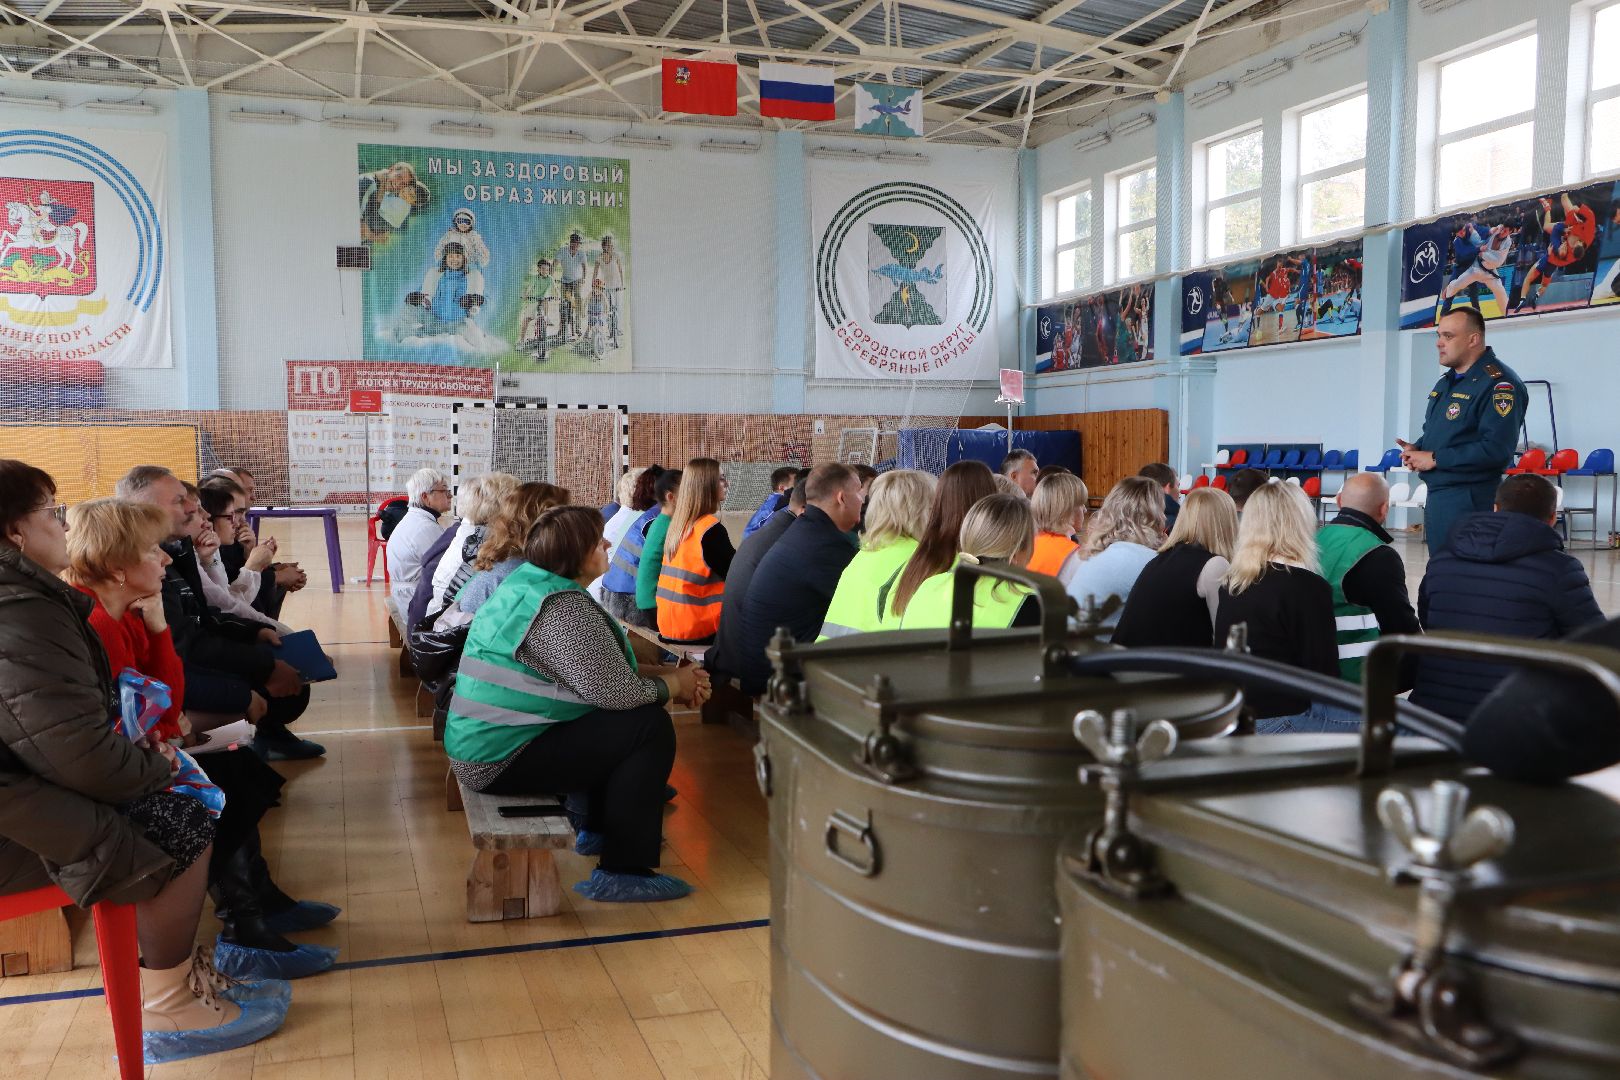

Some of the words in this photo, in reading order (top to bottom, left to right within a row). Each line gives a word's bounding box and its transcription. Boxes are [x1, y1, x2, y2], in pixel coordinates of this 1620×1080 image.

[428, 157, 462, 175] МЫ
[472, 159, 497, 177] ЗА
[505, 161, 624, 184] ЗДОРОВЫЙ
[464, 184, 533, 204] ОБРАЗ
[541, 188, 624, 208] ЖИЗНИ!
[65, 323, 132, 360] ОБЛАСТИ
[837, 327, 930, 375] СЕРЕБРЯНЫЕ
[934, 331, 977, 369] ПРУДЫ
[847, 320, 927, 361] ГОРОДСКОЙ
[930, 322, 966, 356] ОКРУГ
[294, 366, 341, 394] ГТО
[401, 380, 430, 389] ТРУДУ
[431, 381, 438, 390] И
